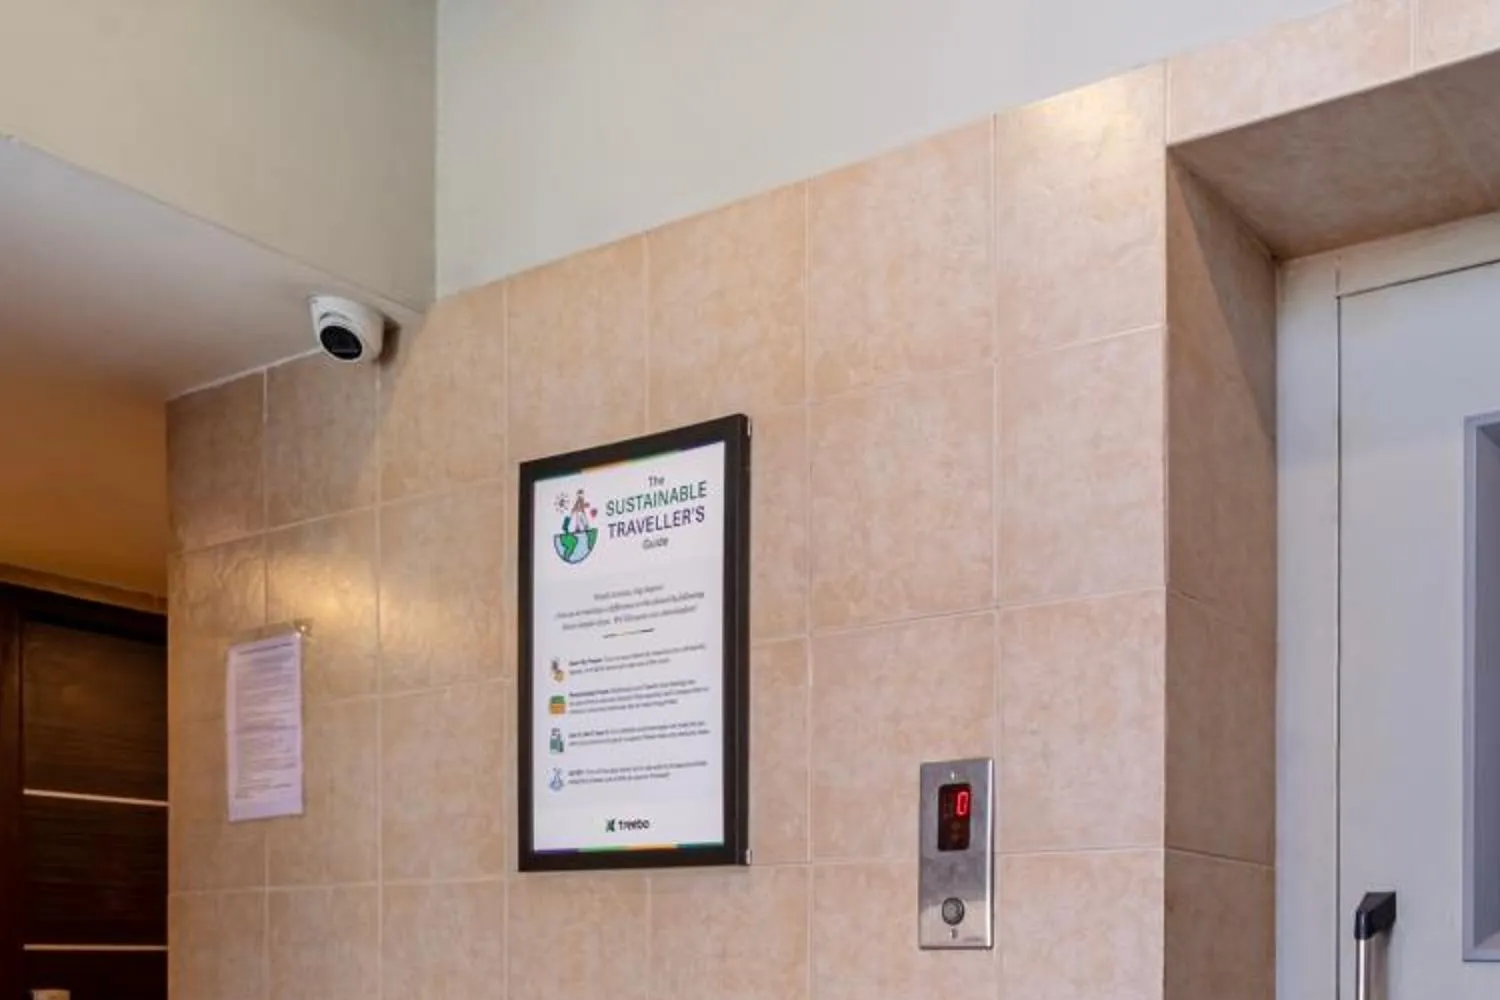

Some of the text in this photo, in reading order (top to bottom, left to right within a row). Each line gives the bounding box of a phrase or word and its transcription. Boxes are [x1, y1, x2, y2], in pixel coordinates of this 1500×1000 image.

[648, 476, 665, 487] The
[606, 480, 707, 517] SUSTAINABLE
[608, 505, 705, 538] TRAVELLER'S
